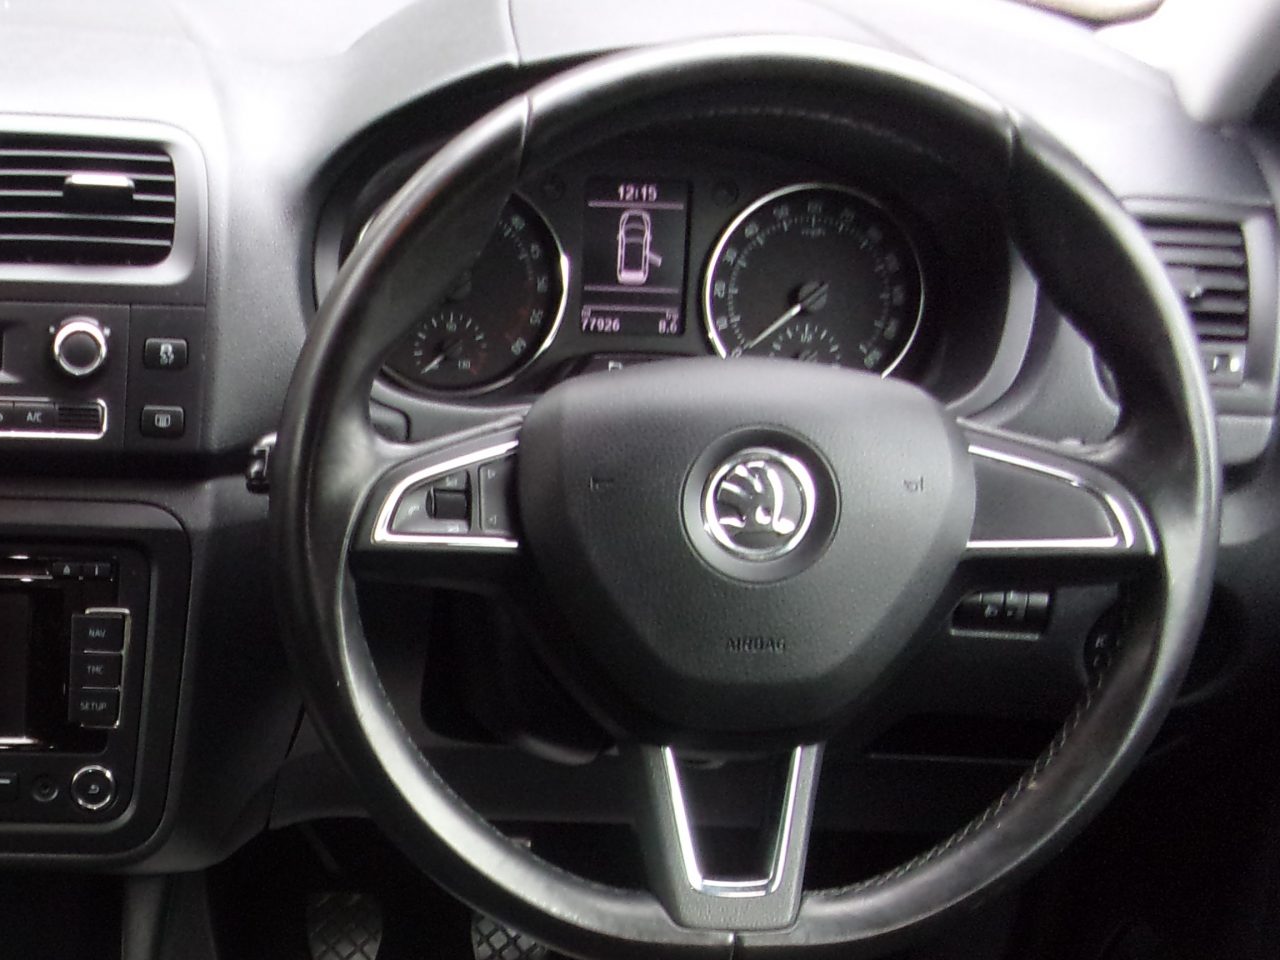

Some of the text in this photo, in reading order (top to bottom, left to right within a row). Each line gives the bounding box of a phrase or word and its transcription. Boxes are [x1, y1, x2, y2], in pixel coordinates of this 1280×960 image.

[618, 184, 657, 201] 12:15
[26, 411, 43, 423] A/C
[88, 628, 107, 638] NAV
[727, 637, 786, 651] AIRBAG
[80, 701, 108, 711] SETUP
